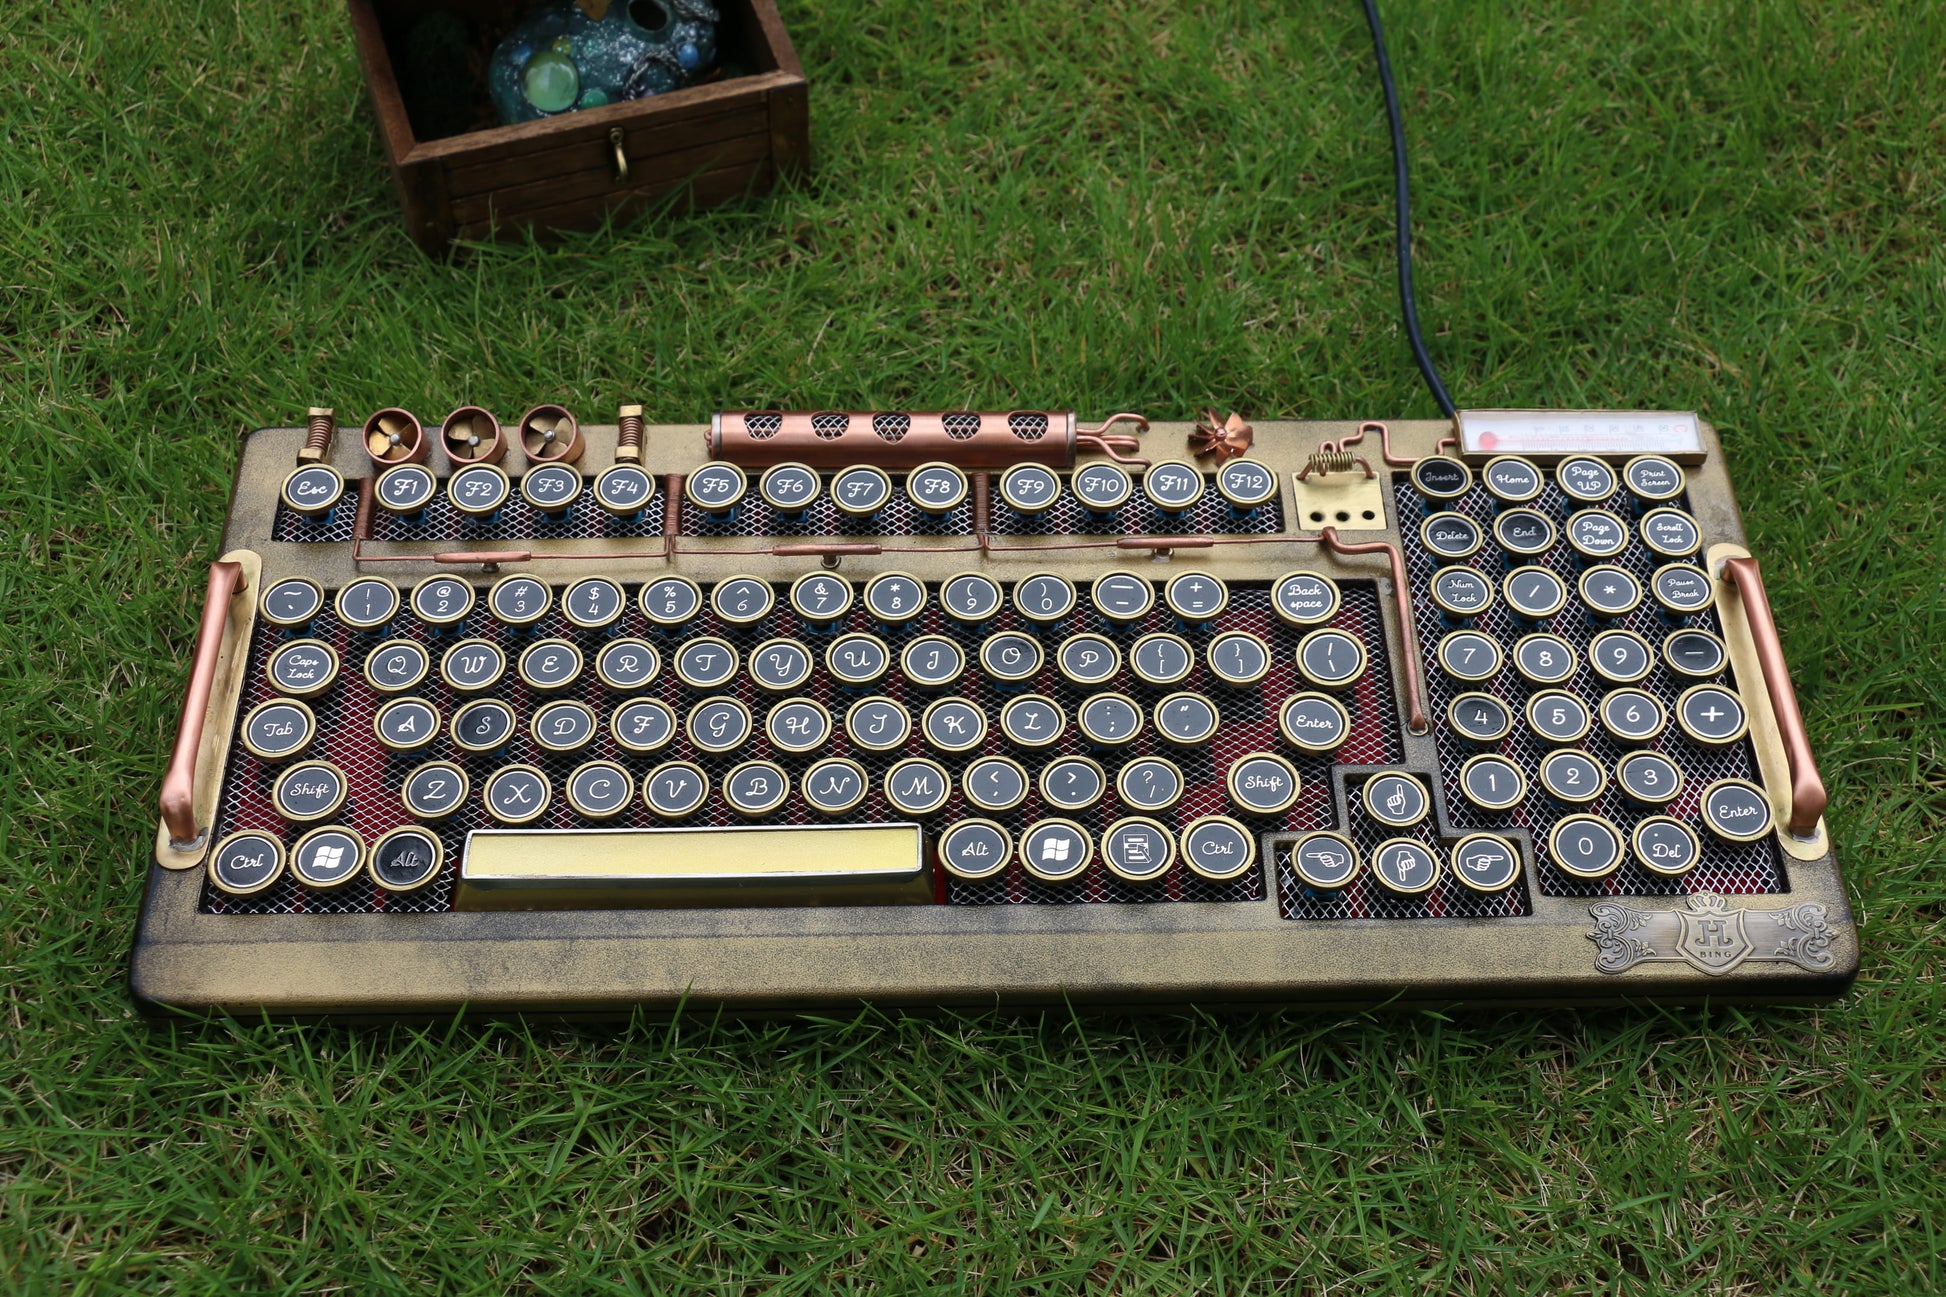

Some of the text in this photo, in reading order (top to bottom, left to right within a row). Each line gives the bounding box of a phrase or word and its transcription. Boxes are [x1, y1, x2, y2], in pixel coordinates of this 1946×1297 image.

[1497, 475, 1529, 483] Home
[1572, 466, 1599, 479] Page
[297, 481, 327, 495] Esc
[394, 479, 417, 495] F1
[466, 481, 492, 496] F2
[539, 478, 564, 492] F3
[612, 479, 637, 494] F4
[703, 478, 729, 493] F5
[777, 479, 803, 494] F6
[925, 479, 950, 494] F8
[1018, 479, 1044, 494] F9
[1085, 477, 1118, 492] F10
[1160, 475, 1188, 491] F11
[1230, 474, 1262, 488] F12
[1578, 481, 1601, 492] UP
[847, 482, 874, 497] F7
[1513, 527, 1536, 537] End
[1583, 520, 1609, 534] Page
[1657, 522, 1683, 531] Scroll
[1436, 531, 1468, 540] Delete
[1583, 536, 1614, 545] Down
[1662, 535, 1683, 543] Lock
[437, 586, 451, 597] @
[515, 586, 528, 597] #
[664, 586, 676, 597] %
[815, 583, 828, 595] &
[1190, 582, 1202, 592] +
[1288, 585, 1321, 595] Back
[1449, 580, 1473, 588] Num
[589, 587, 599, 600] $
[1452, 593, 1476, 602] Lock
[1672, 589, 1699, 598] Break
[437, 600, 448, 612] 2
[515, 601, 525, 612] 3
[589, 603, 598, 615] 4
[665, 601, 675, 613] 5
[738, 600, 747, 611] 6
[817, 597, 827, 609] 7
[892, 597, 901, 609] 8
[967, 598, 976, 610] 9
[1042, 598, 1052, 610] 0
[1290, 601, 1322, 609] space
[289, 655, 319, 667] Caps
[616, 655, 639, 672] R
[696, 655, 716, 671] T
[845, 651, 870, 667] U
[1002, 648, 1021, 664] O
[1079, 651, 1099, 667] P
[1464, 648, 1476, 664] 7
[1540, 651, 1552, 666] 8
[1614, 648, 1627, 664] 9
[388, 656, 406, 674] Q
[461, 656, 487, 673] W
[542, 656, 559, 672] E
[770, 654, 792, 676] Y
[287, 669, 314, 678] Lock
[1024, 713, 1041, 729] L
[1474, 710, 1488, 724] 4
[1552, 709, 1565, 724] 5
[1627, 705, 1640, 722] 6
[1701, 706, 1724, 722] +
[264, 722, 292, 736] Tab
[398, 716, 415, 732] A
[476, 716, 490, 734] S
[554, 718, 576, 735] D
[634, 716, 654, 733] F
[710, 712, 729, 737] G
[786, 717, 810, 734] H
[870, 714, 887, 733] J
[944, 716, 965, 734] K
[1296, 715, 1333, 728] Enter
[991, 771, 998, 782] <
[1068, 772, 1076, 783] >
[1143, 771, 1153, 783] ?
[1245, 776, 1283, 791] Shift
[1567, 768, 1580, 784] 2
[1644, 770, 1657, 785] 3
[290, 782, 329, 797] Shift
[423, 781, 446, 799] Z
[589, 780, 610, 798] C
[666, 780, 687, 798] V
[746, 778, 767, 796] B
[820, 777, 850, 794] N
[902, 777, 932, 795] M
[504, 784, 530, 804] X
[1720, 805, 1758, 818] Enter
[962, 842, 989, 856] Alt
[1202, 841, 1233, 855] Ctrl
[1579, 837, 1593, 855] 0
[1653, 844, 1681, 857] Del
[231, 854, 264, 869] Ctrl
[391, 851, 419, 866] Alt
[1695, 920, 1733, 947] H
